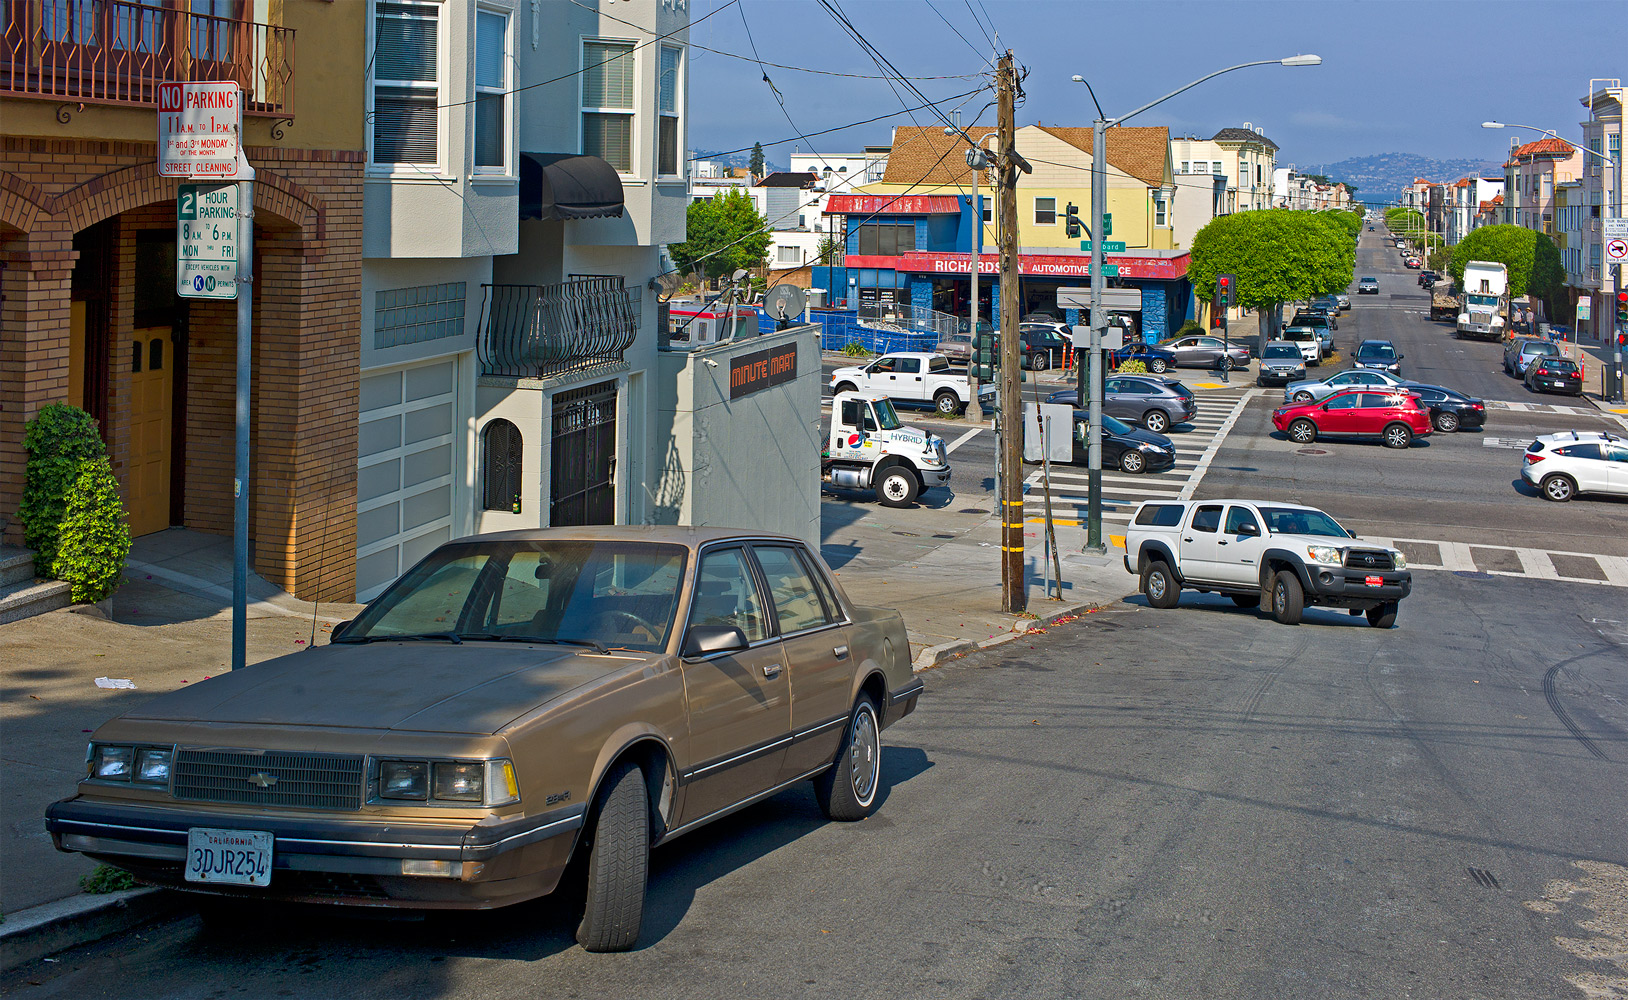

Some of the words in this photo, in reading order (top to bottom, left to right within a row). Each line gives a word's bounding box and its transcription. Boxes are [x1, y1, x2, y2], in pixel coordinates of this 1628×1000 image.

[162, 86, 180, 109] NO
[186, 91, 233, 109] PARKING
[210, 116, 214, 132] 1
[176, 140, 188, 148] and
[190, 140, 200, 148] 3rd
[201, 139, 228, 148] MONDAY
[165, 163, 191, 172] STREET
[196, 163, 232, 172] CLEANING
[182, 192, 193, 213] 2
[206, 192, 228, 204] HOUR
[200, 207, 234, 218] PARKING
[183, 223, 189, 240] 8
[213, 224, 219, 240] 6
[183, 245, 198, 256] MON
[222, 246, 234, 257] FRI
[1032, 264, 1088, 274] AUTOMOTIVE
[196, 278, 202, 289] K
[208, 278, 214, 289] M
[732, 360, 767, 388] MINUTE
[770, 352, 795, 376] MART
[891, 433, 922, 444] HYBRID
[209, 837, 253, 846] CALIFORNIA
[192, 848, 265, 876] 3DJR254
